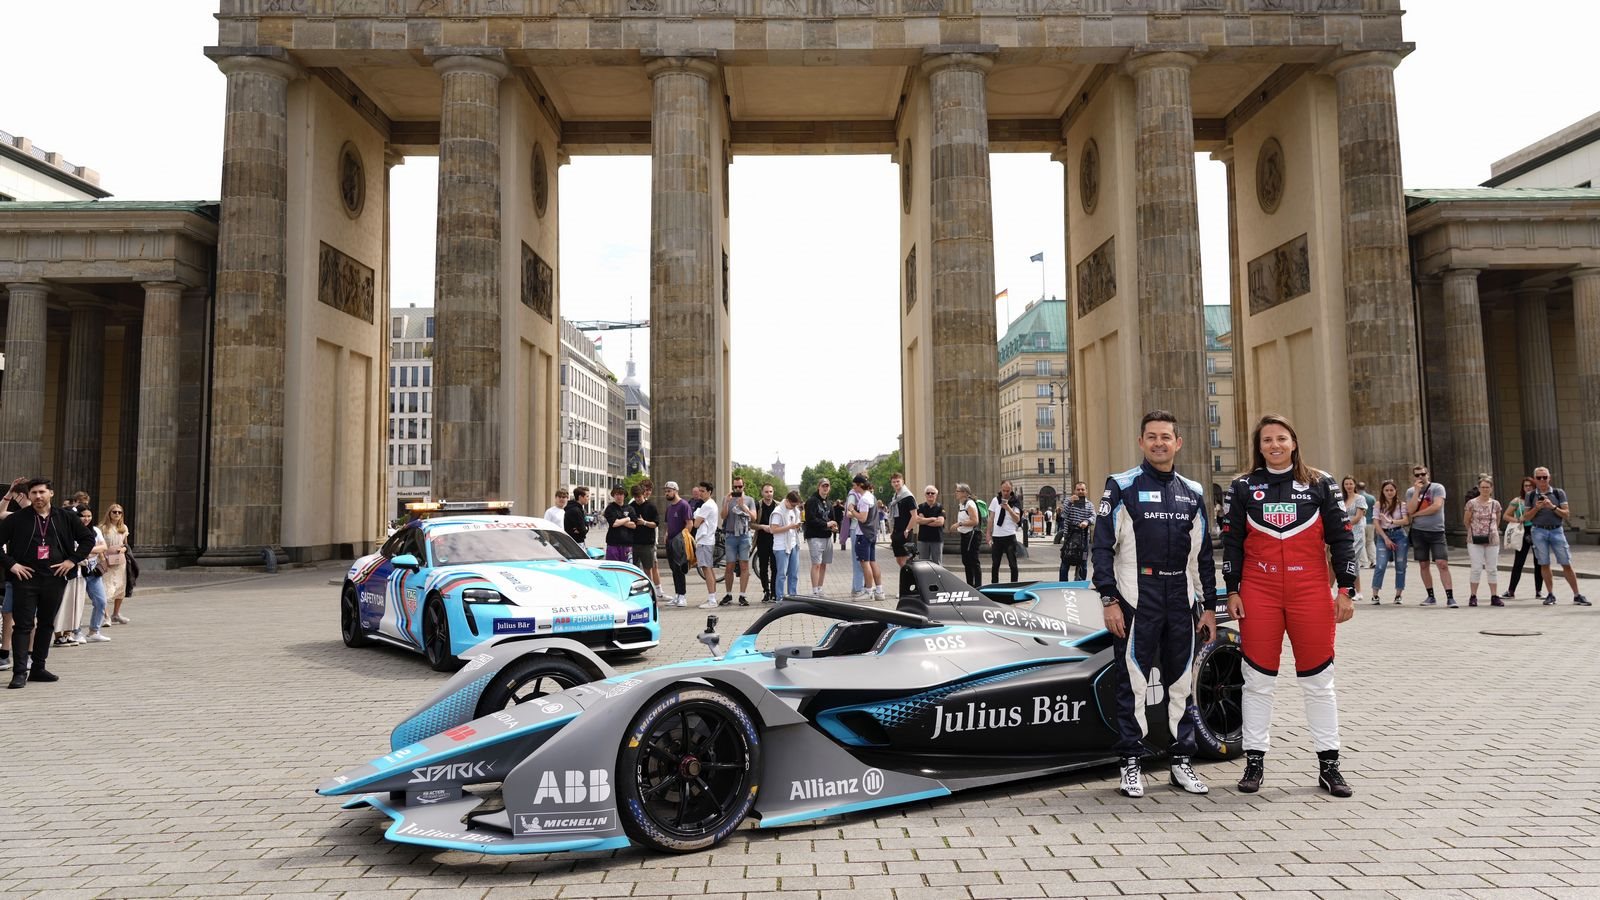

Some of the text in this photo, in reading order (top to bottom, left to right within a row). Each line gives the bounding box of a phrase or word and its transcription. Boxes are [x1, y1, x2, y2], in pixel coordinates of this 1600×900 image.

[1265, 504, 1294, 513] TAG
[1265, 514, 1295, 527] HEUER
[360, 591, 377, 604] SAFETY
[936, 591, 974, 603] DHL
[551, 603, 610, 614] SAFETY CAR
[497, 622, 516, 630] Julius
[572, 614, 607, 623] FORMULA
[982, 609, 1068, 637] enel way
[925, 635, 966, 650] BOSS
[640, 697, 676, 732] MICHELIN
[931, 695, 1086, 739] Julius Bär
[1192, 709, 1217, 748] MICHELIN
[408, 761, 486, 784] SPARK
[533, 769, 611, 805] ABB
[790, 777, 858, 801] Allianz
[543, 816, 608, 829] MICHELIN
[396, 822, 502, 842] Julius Bär
